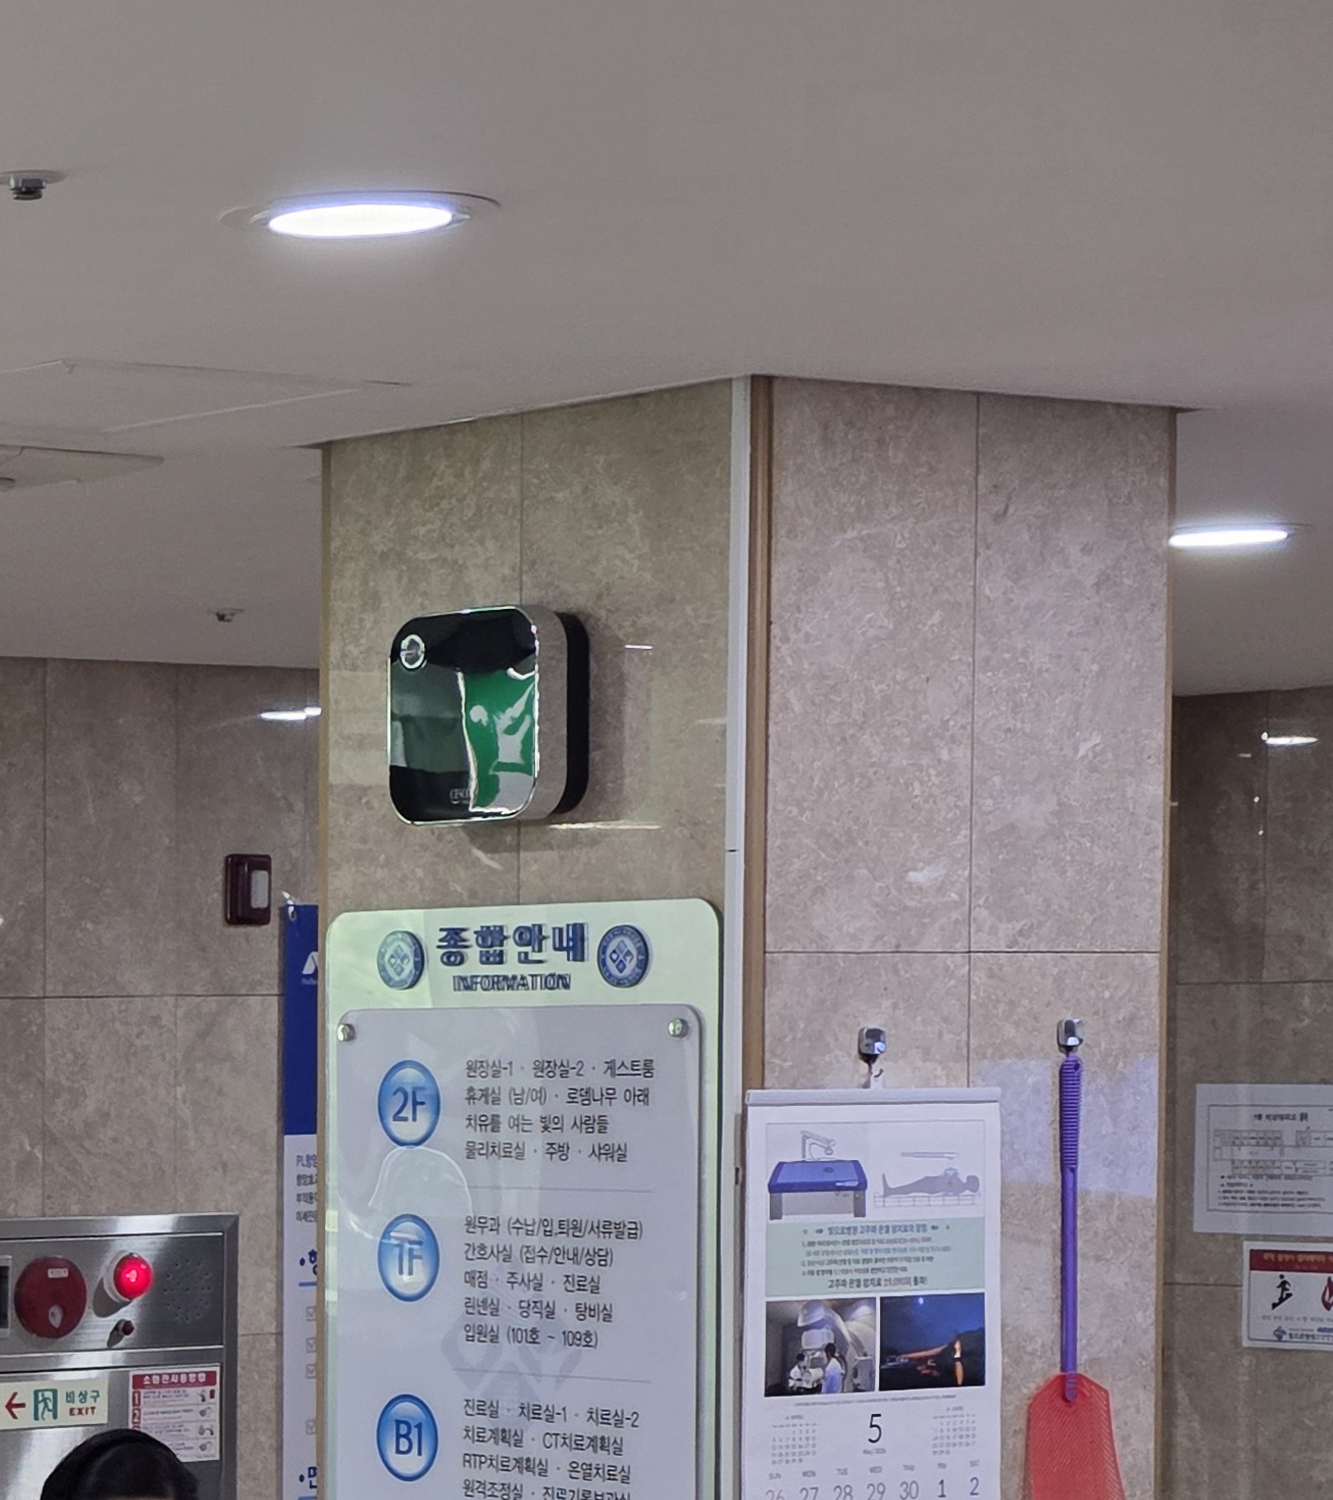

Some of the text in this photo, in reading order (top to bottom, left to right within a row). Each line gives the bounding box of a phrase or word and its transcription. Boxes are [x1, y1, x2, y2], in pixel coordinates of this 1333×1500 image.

[437, 922, 589, 966] 종합안내
[453, 973, 571, 991] INFORMATION
[465, 1059, 655, 1079] 원장실-1 원장실-2 게스트룸
[392, 1087, 427, 1122] 2F
[465, 1087, 650, 1106] 휴게실 (남/여) 로뎀나무 아래
[465, 1115, 609, 1134] 치유를 여는 빛의 사람들
[464, 1142, 628, 1163] 물리치료실 주방 샤워실
[464, 1217, 501, 1236] 원무과
[464, 1244, 614, 1267] 간호사실 (접수/안내/상담)
[464, 1271, 601, 1294] 매점 주사실 진료실
[464, 1298, 613, 1323] 린넨실 당직실 탕비실
[464, 1325, 598, 1349] 입원실 (101호 109호)
[66, 1390, 100, 1404] 비상구
[69, 1406, 96, 1416] EXIT
[463, 1399, 639, 1428] 진료실 치료실-1 치료실-2
[394, 1419, 423, 1456] B1
[867, 1413, 882, 1443] 5
[463, 1425, 623, 1456] 치료계획실 CT치료계획실
[462, 1453, 631, 1485] RTP치료계획실 온열치료실
[462, 1479, 523, 1500] 원격조정실
[938, 1476, 980, 1498] 1 2
